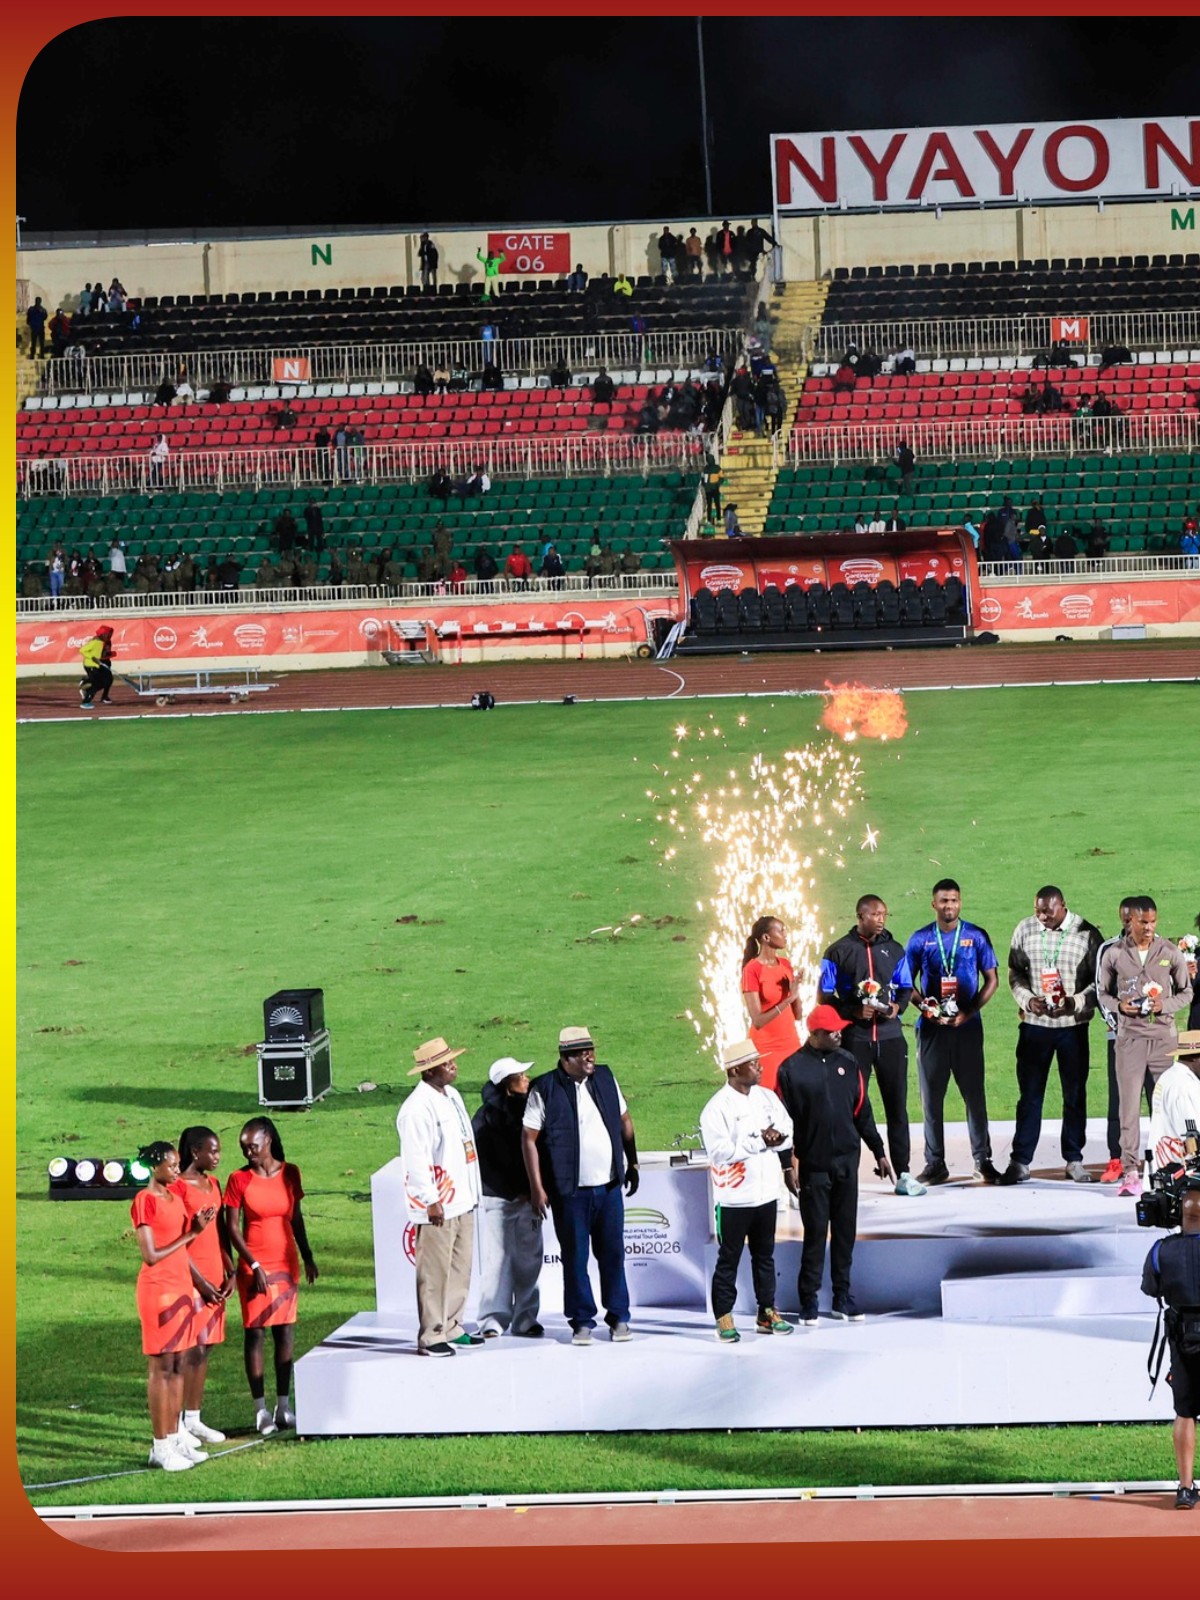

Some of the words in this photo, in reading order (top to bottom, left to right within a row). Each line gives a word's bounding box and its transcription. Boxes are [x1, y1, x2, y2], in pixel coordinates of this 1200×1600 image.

[774, 124, 1110, 204] NYAYO
[1170, 207, 1195, 230] M
[505, 234, 554, 250] GATE
[311, 243, 332, 266] N
[516, 255, 545, 272] 06
[1061, 319, 1080, 339] M
[283, 360, 300, 378] N
[624, 1240, 681, 1255] obi2026
